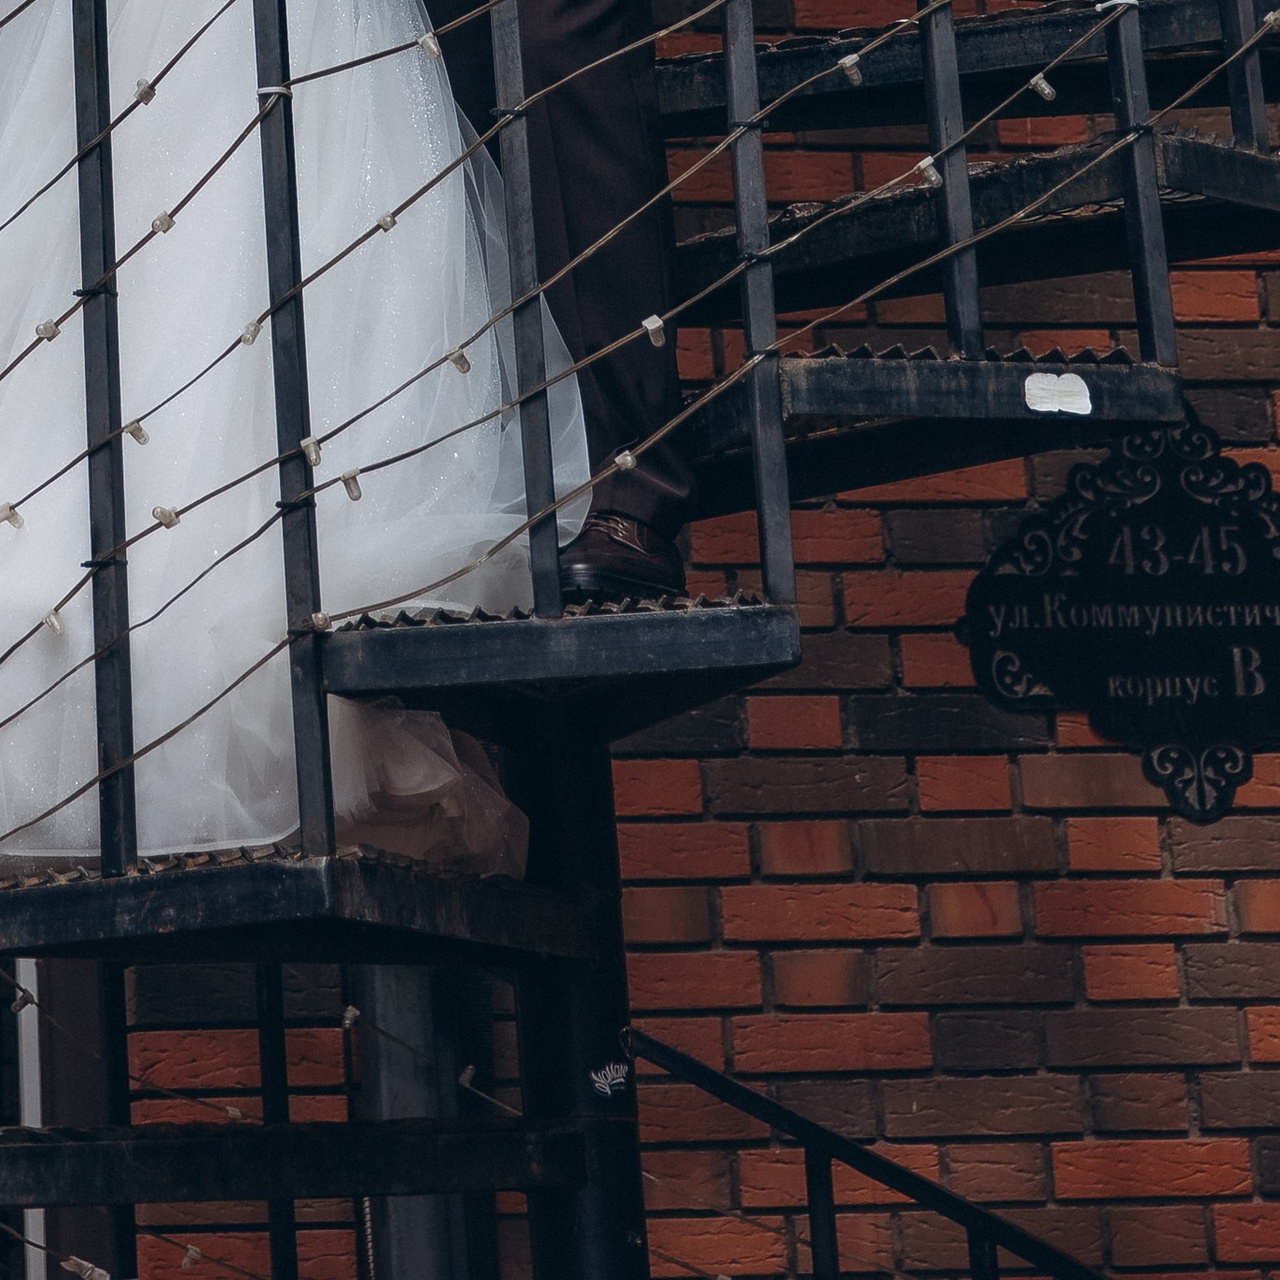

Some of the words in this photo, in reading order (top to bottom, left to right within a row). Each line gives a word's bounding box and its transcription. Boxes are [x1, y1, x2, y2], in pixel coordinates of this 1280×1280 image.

[1108, 525, 1247, 576] 43-45
[1108, 675, 1220, 706] корпус
[1232, 645, 1266, 698] В
